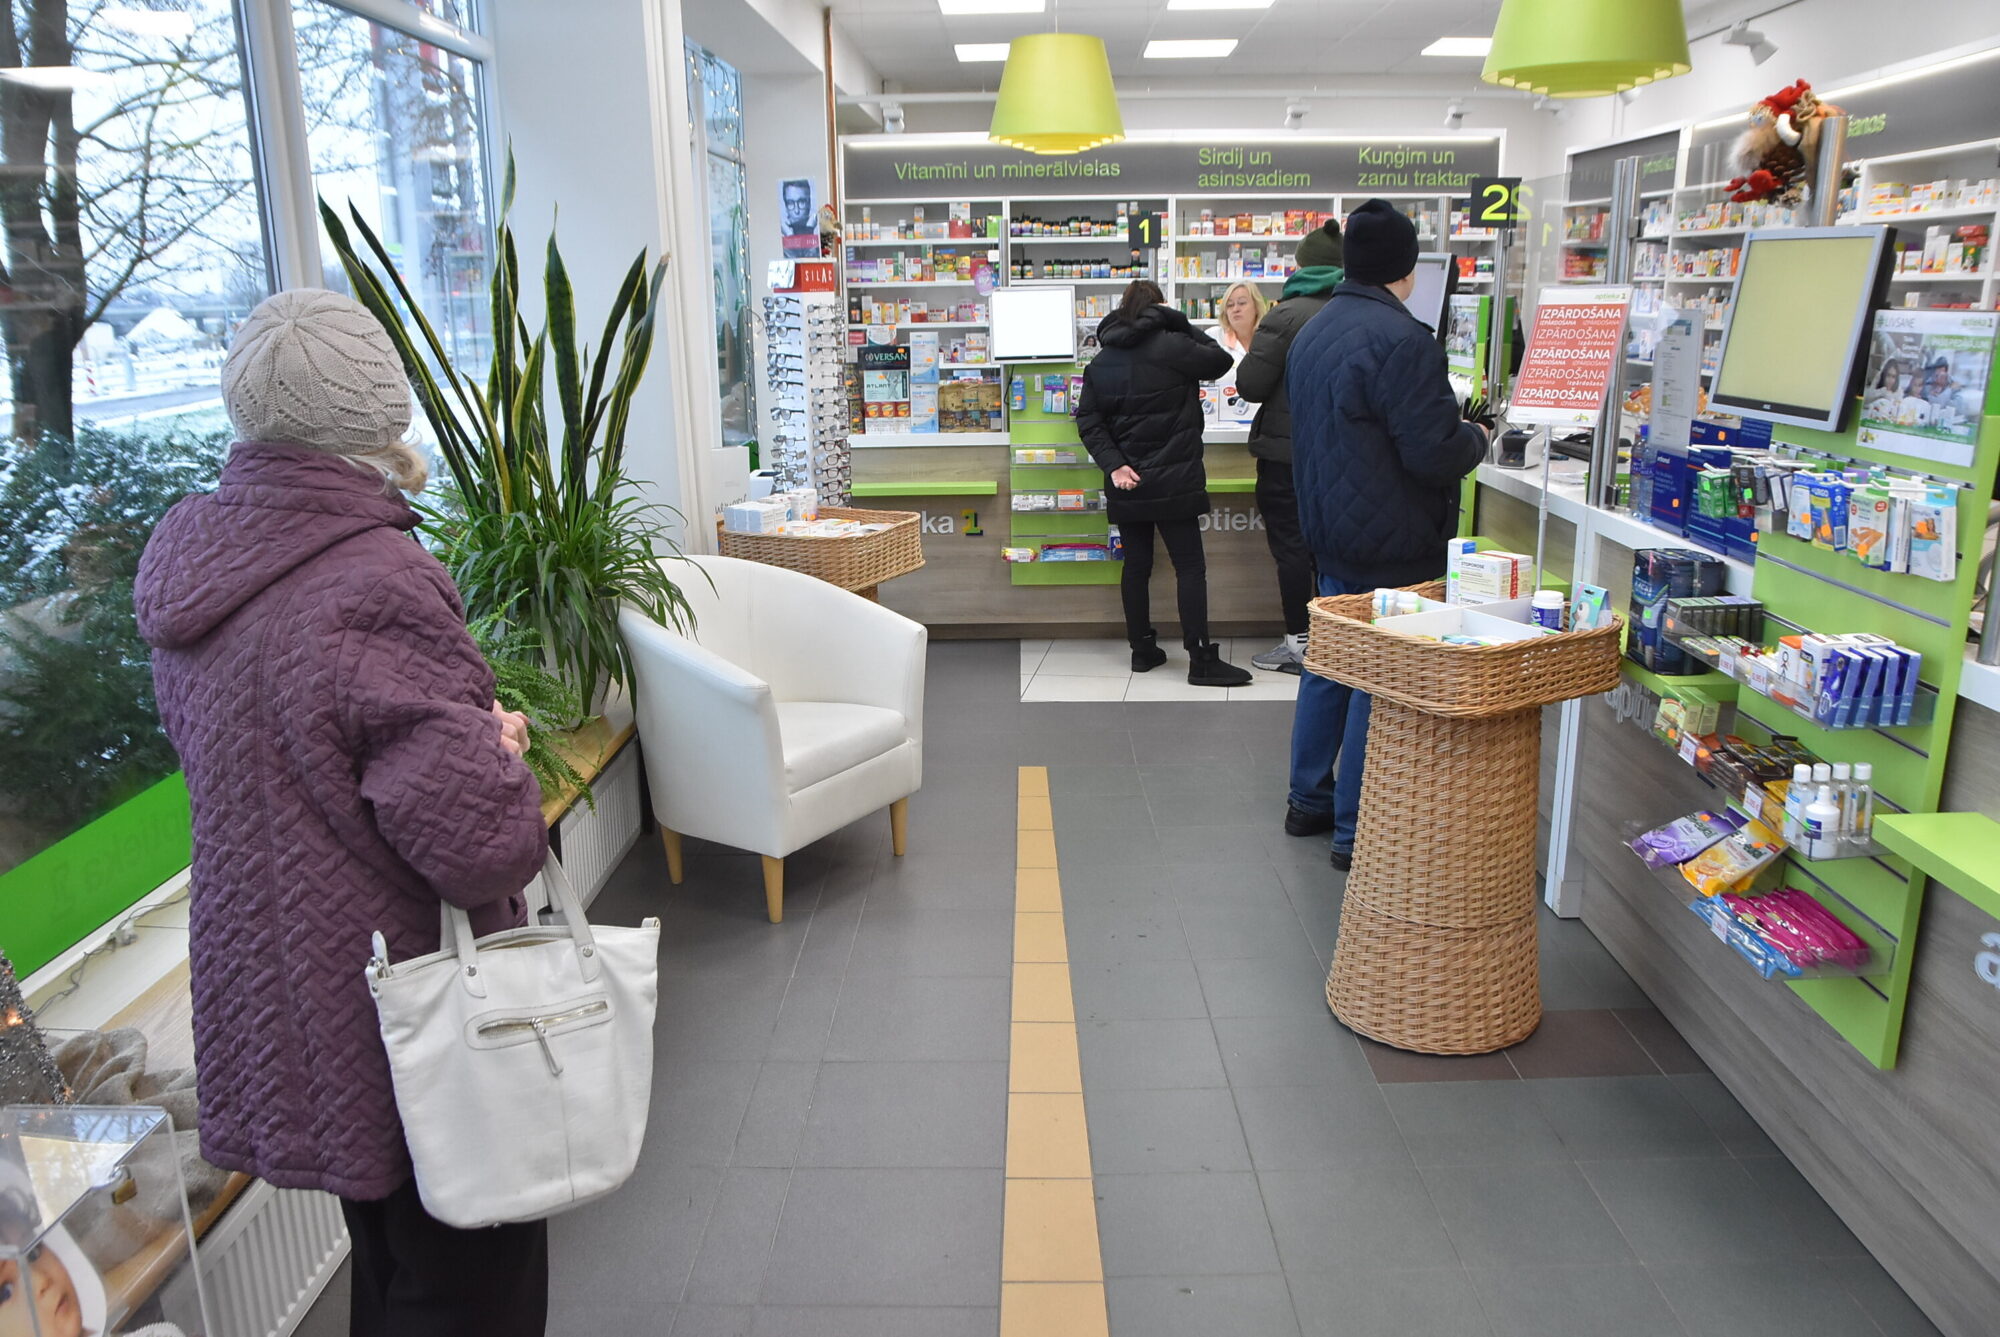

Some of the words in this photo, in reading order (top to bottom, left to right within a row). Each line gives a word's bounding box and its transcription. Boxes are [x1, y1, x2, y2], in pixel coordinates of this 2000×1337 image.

[1199, 148, 1244, 169] Sirdij
[1249, 152, 1272, 166] un
[1358, 145, 1427, 169] Kuņģim
[1433, 150, 1455, 164] un
[895, 162, 968, 180] Vitamīni
[973, 163, 996, 178] un
[1001, 159, 1121, 179] minerālvielas
[1198, 168, 1311, 187] asinsvadiem
[1358, 172, 1408, 187] zarnu
[1481, 184, 1509, 220] 2
[1139, 219, 1149, 244] 1
[805, 267, 833, 283] SILAC
[1541, 307, 1621, 318] IZPĀRDOŠANA
[1884, 316, 1916, 328] LIVSANE
[1536, 327, 1616, 339] IZPĀRDOŠANA
[1531, 347, 1610, 359] IZPĀRDOŠANA
[1525, 367, 1605, 379] IZPĀRDOŠANA
[1519, 387, 1599, 400] IZPĀRDOŠANA
[961, 508, 984, 536] 1
